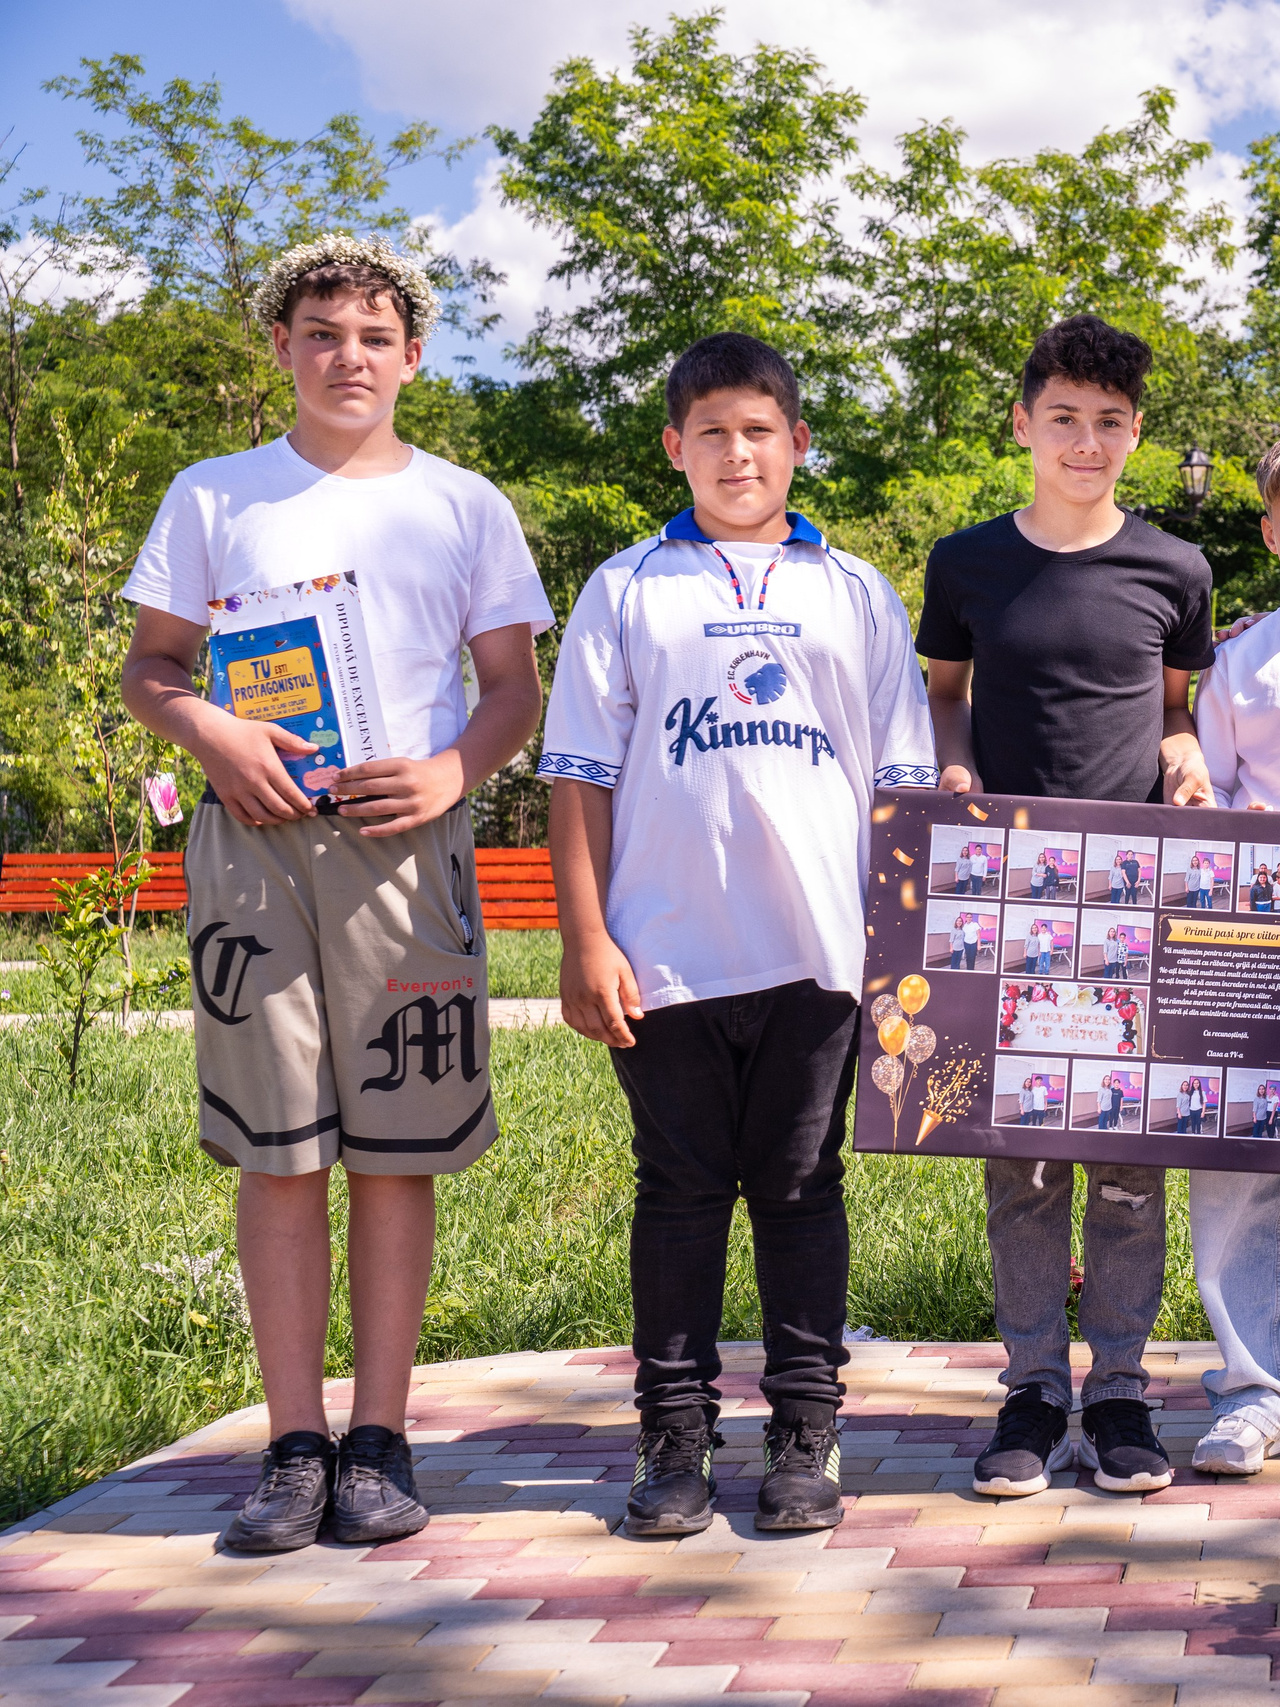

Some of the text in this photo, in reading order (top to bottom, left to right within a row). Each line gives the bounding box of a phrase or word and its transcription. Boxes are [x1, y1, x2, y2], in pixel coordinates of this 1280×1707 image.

[726, 623, 796, 635] UMBRO
[250, 659, 288, 680] TU EȘTI
[234, 673, 315, 702] PROTAGONISTUL!
[336, 603, 377, 761] DIPLOMĂ DE EXCELENȚĂ
[665, 696, 836, 767] Kinnarps
[1184, 926, 1280, 941] Primii pași spre viitor
[1232, 951, 1249, 959] patru
[387, 977, 474, 995] Everyon's
[1197, 989, 1218, 998] privim
[1226, 991, 1242, 1000] curaj
[1216, 1001, 1233, 1009] parte
[1261, 1002, 1272, 1010] din
[1252, 1012, 1263, 1020] cele
[1203, 1029, 1211, 1037] Cu
[360, 993, 482, 1095] M
